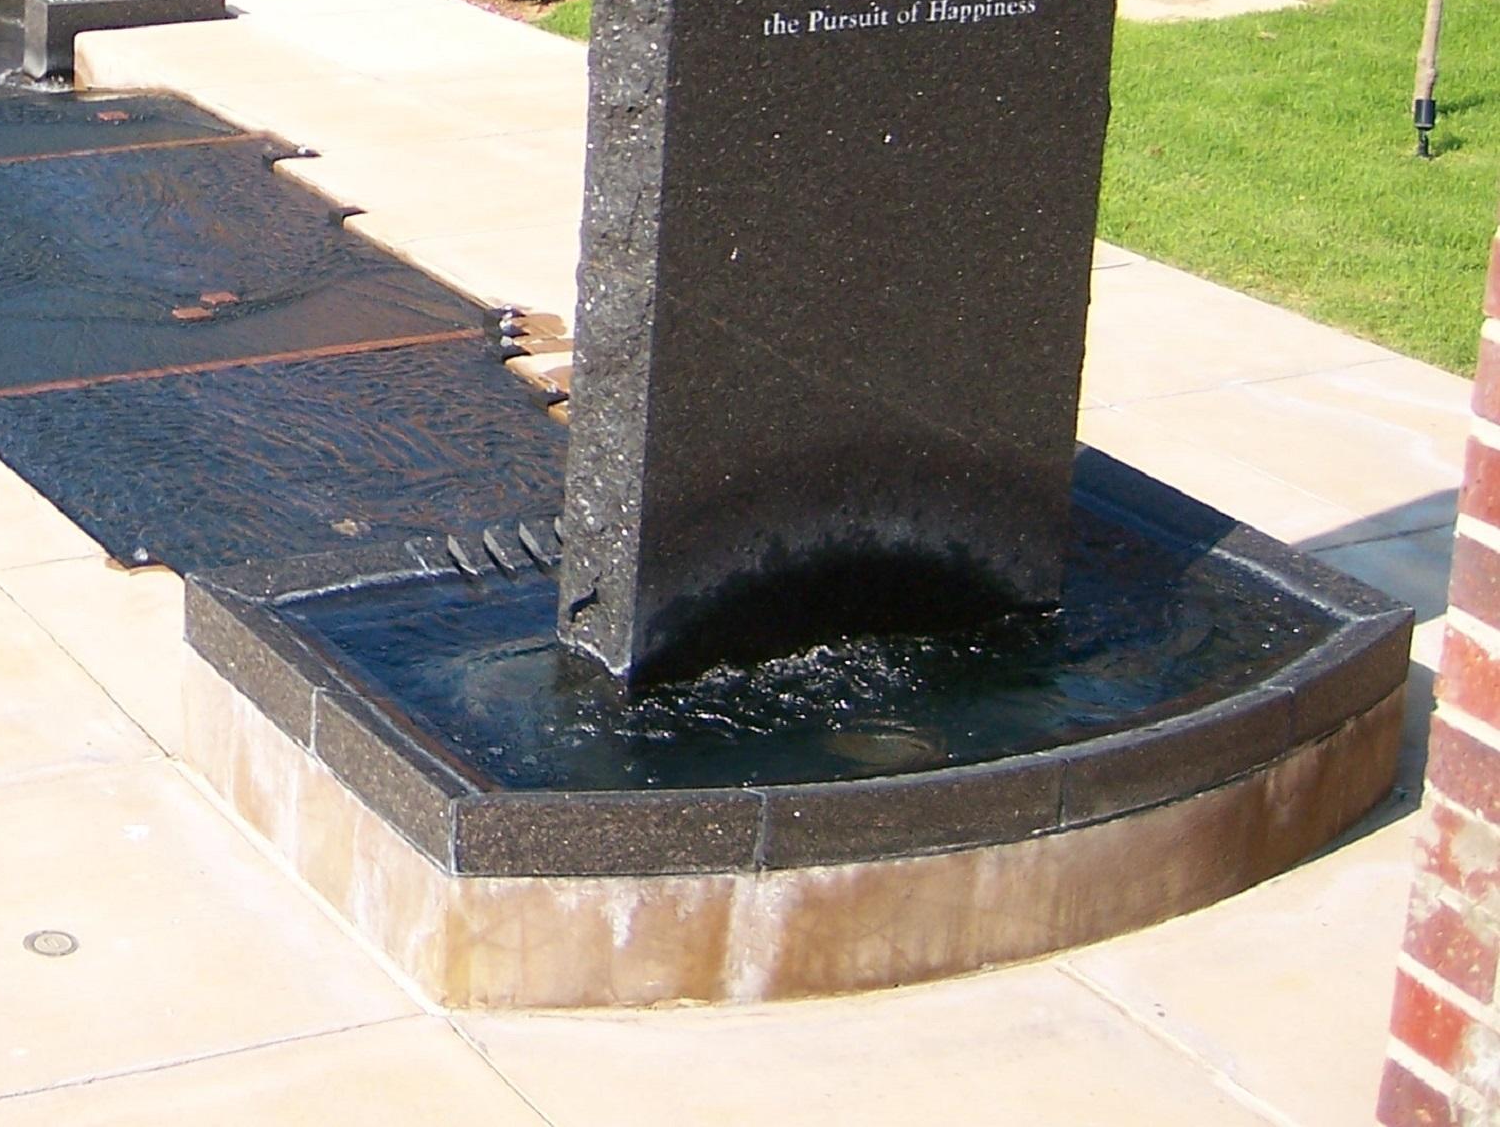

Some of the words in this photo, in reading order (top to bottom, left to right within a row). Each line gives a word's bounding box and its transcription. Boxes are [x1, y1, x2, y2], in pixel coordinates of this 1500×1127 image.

[764, 14, 800, 36] the
[808, 6, 888, 33] Pursuit
[897, 3, 921, 25] of
